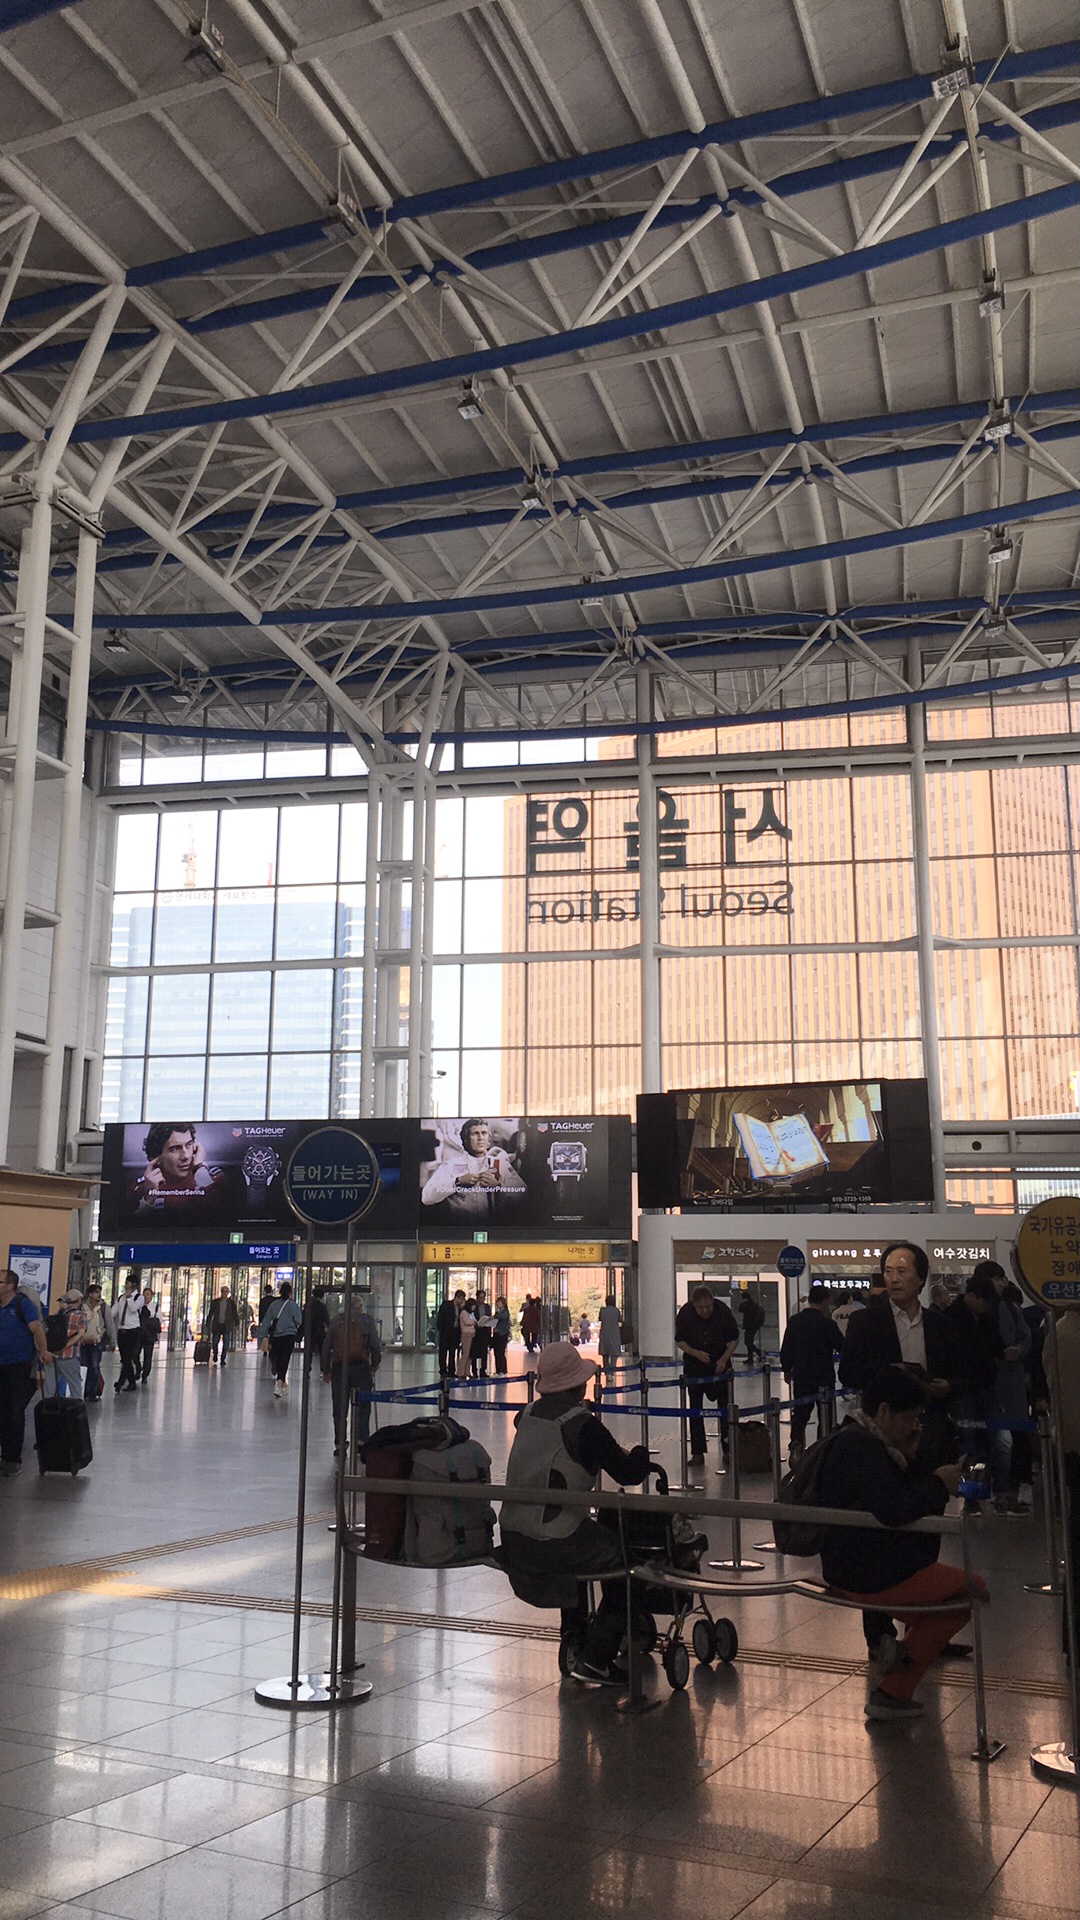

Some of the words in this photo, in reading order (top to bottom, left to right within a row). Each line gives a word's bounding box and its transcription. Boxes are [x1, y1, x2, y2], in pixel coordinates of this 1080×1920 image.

[176, 891, 217, 901] 연세대학
[291, 1164, 371, 1182] 들어가는곳
[303, 1188, 334, 1201] (WAY
[341, 1188, 358, 1200] IN)
[1029, 1215, 1080, 1237] 국가유공
[129, 1247, 135, 1259] 1
[432, 1247, 437, 1259] 1
[811, 1248, 858, 1258] ginseng
[933, 1247, 990, 1259] 여수갓김치
[823, 1280, 870, 1289] 즉석호두과자
[628, 1407, 650, 1415] KORAIL
[699, 1409, 722, 1417] KORAIL
[956, 1419, 988, 1429] KORAIL
